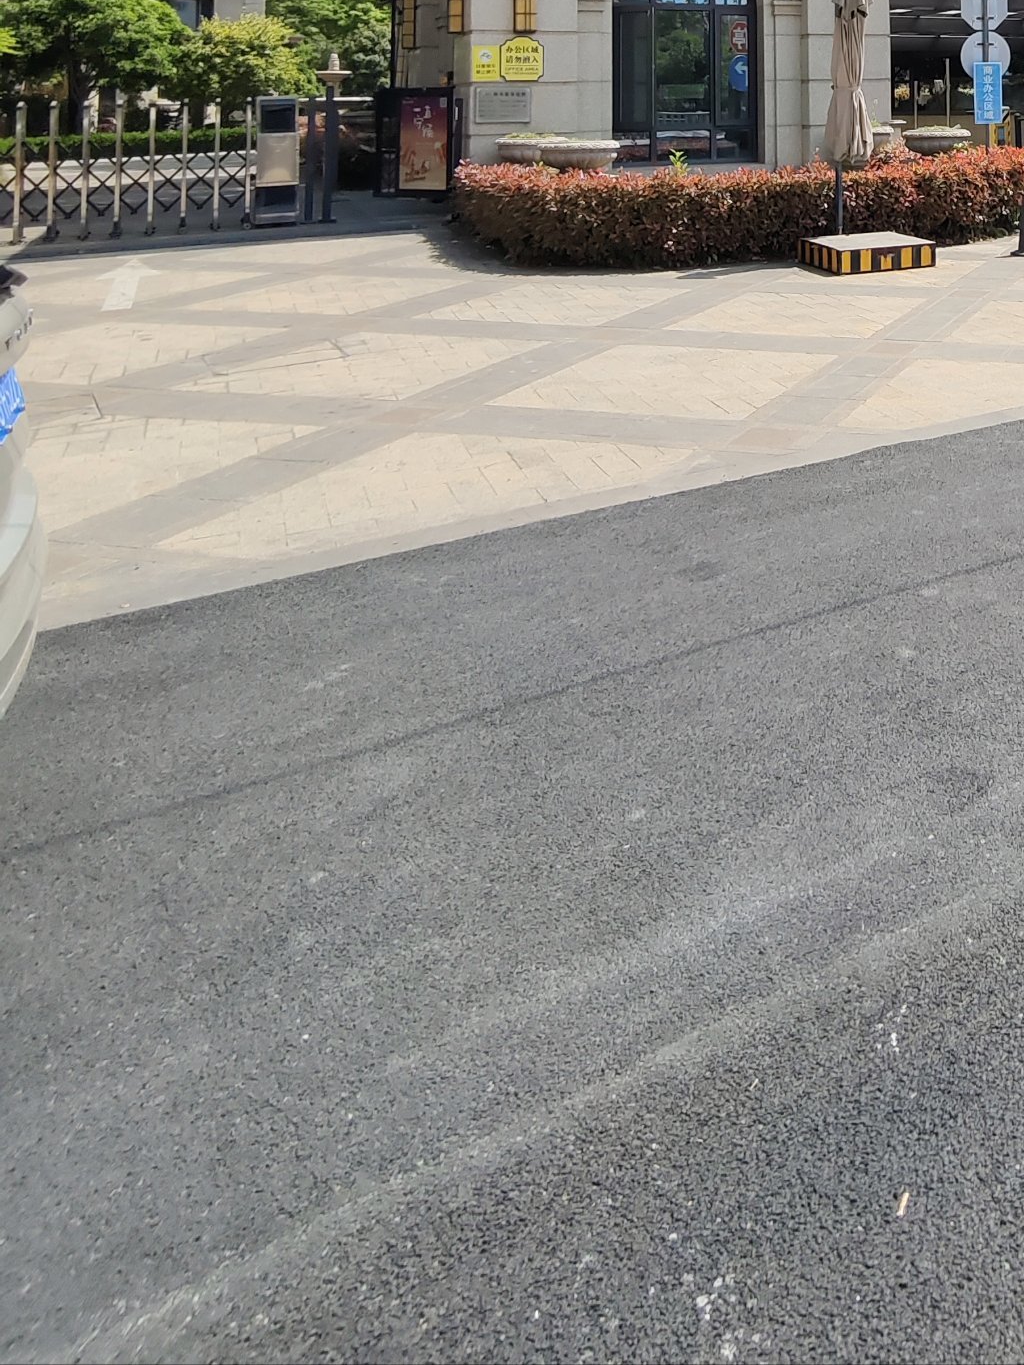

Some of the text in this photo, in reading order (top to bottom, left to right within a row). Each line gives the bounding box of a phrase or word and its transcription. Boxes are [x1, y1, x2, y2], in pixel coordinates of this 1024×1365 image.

[505, 45, 540, 54] 办公区域
[983, 65, 995, 120] 商业办公区域
